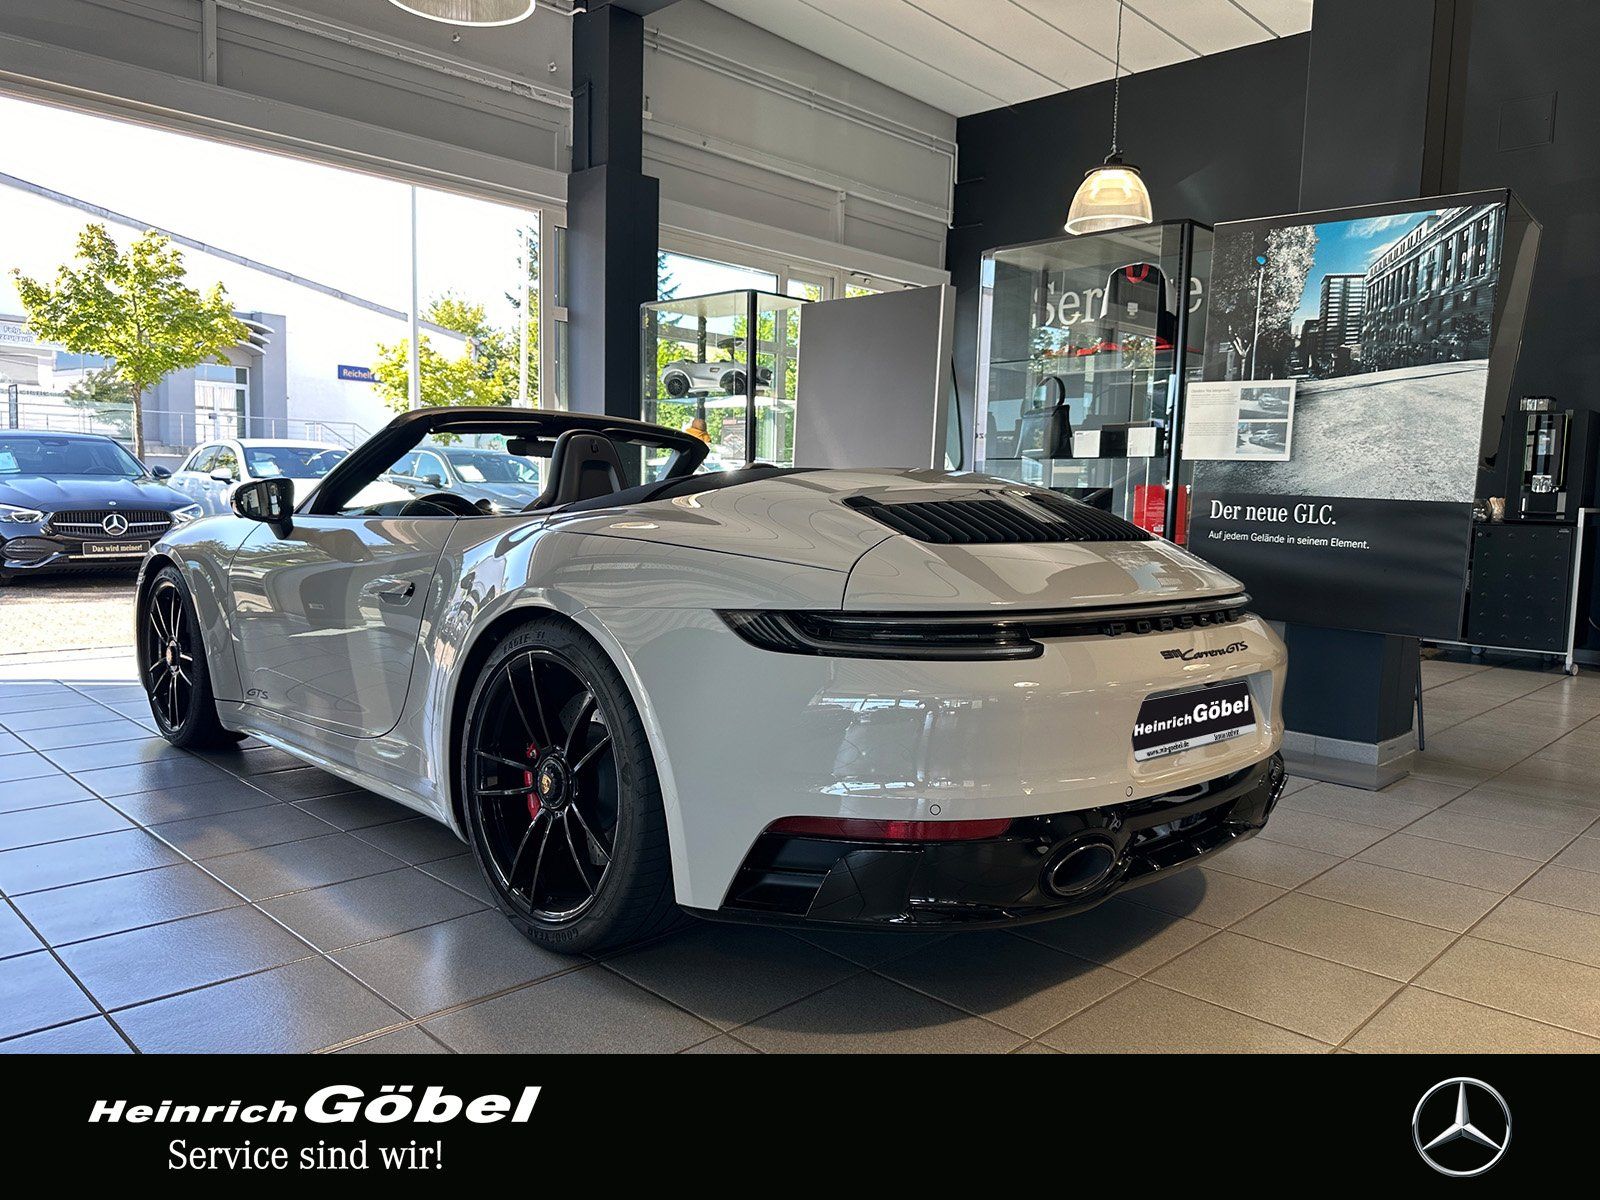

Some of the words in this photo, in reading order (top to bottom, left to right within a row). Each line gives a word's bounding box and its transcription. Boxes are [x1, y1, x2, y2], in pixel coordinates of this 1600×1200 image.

[1210, 500, 1242, 520] Der
[1245, 506, 1288, 522] neue
[1294, 503, 1337, 525] GLC.
[120, 544, 143, 552] meiner!
[1208, 530, 1223, 540] Auf
[1222, 531, 1249, 542] jedem
[1250, 532, 1285, 544] Gelände
[1286, 534, 1295, 544] in
[1297, 536, 1329, 547] seinem
[1330, 536, 1370, 549] Element.
[1181, 648, 1227, 661] Carrera
[1225, 641, 1249, 654] GTS
[246, 688, 269, 700] GTS
